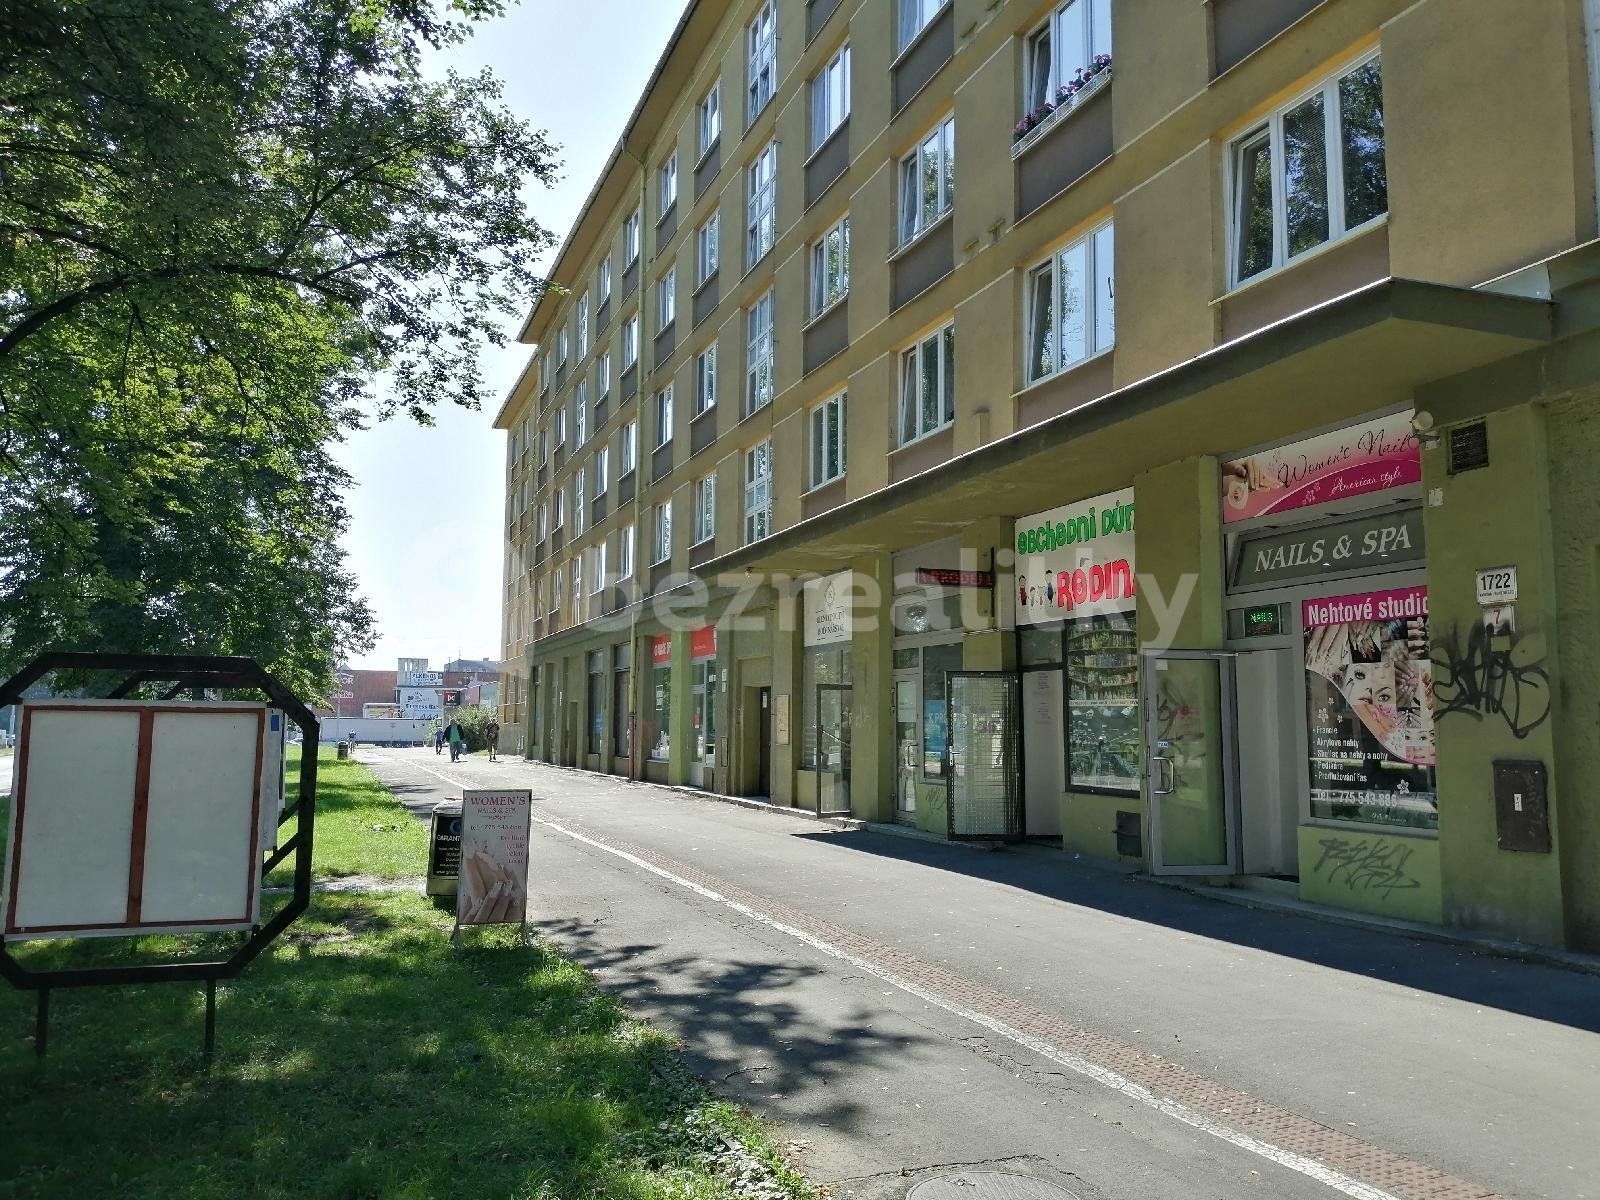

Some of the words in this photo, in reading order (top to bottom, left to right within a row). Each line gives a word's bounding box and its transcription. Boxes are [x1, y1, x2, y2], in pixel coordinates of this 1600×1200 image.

[1254, 539, 1325, 573] NAILS
[1332, 535, 1353, 560] &
[1361, 525, 1412, 556] SPA
[1056, 559, 1137, 612] RODIN
[1480, 572, 1511, 591] 1722
[1308, 598, 1374, 625] Nehtové
[1493, 609, 1501, 625] 7
[470, 796, 526, 806] WOMEN'S
